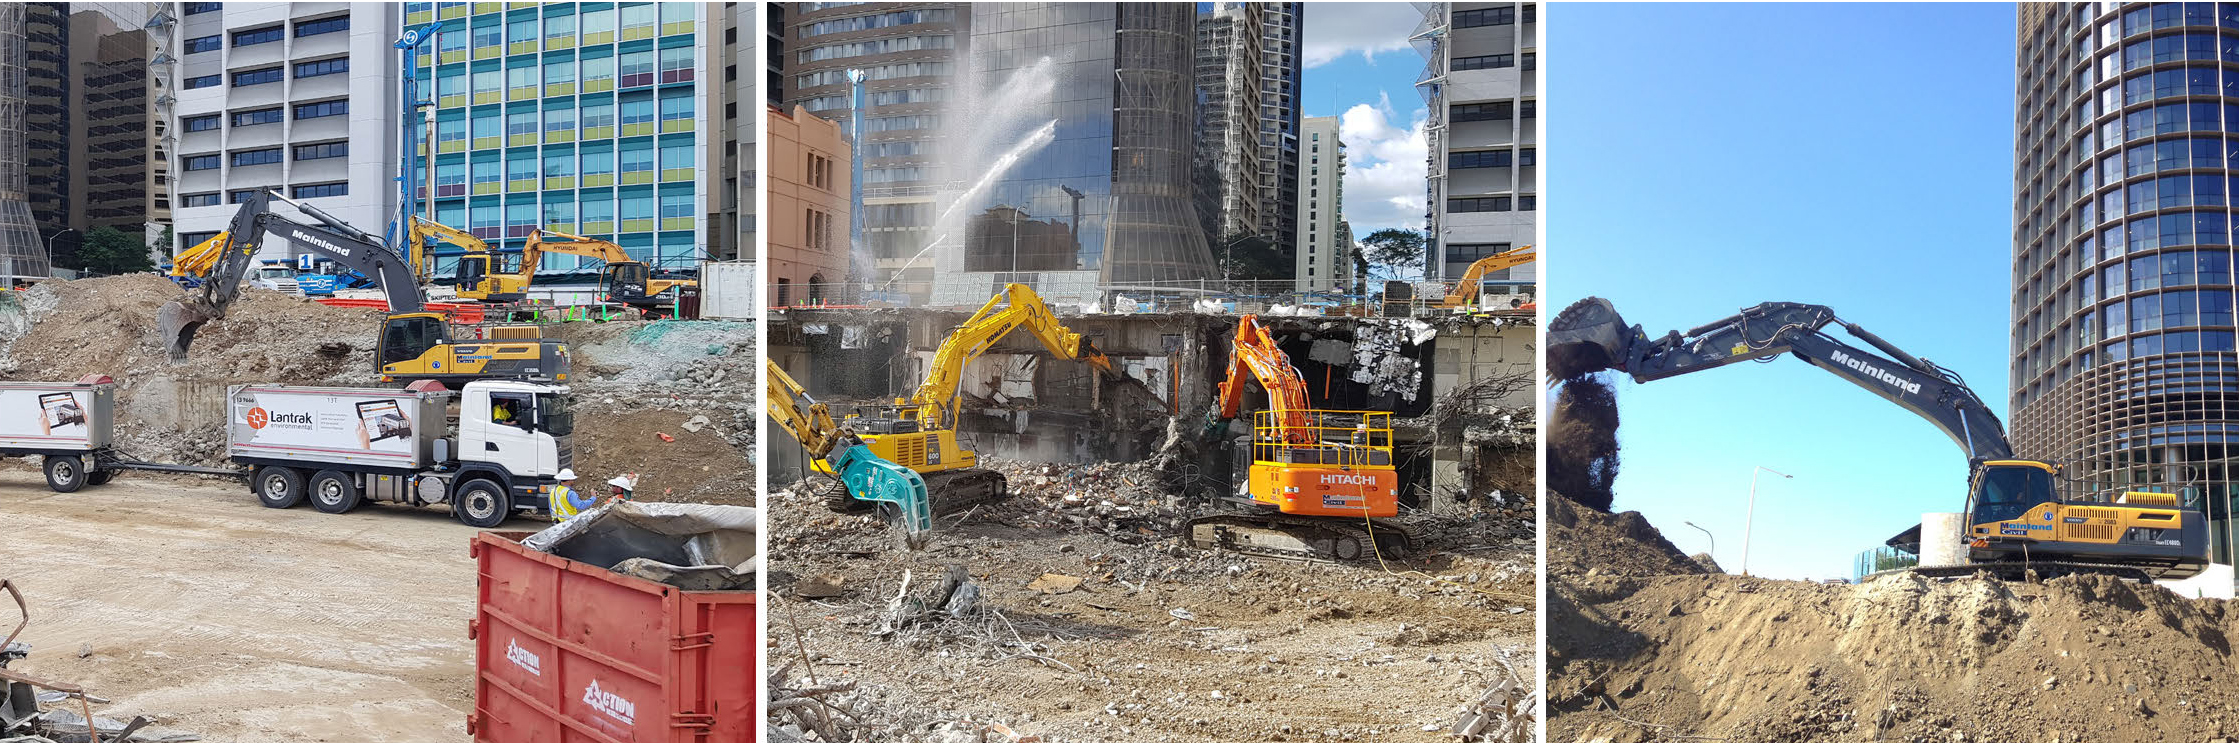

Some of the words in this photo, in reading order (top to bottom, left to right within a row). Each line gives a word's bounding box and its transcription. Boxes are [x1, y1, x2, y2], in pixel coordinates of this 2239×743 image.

[292, 229, 351, 257] Mainland
[301, 254, 311, 269] 1
[1508, 255, 1534, 264] HYUNDAI
[986, 321, 1012, 345] KOMATSU
[1830, 349, 1922, 395] Mainland
[270, 410, 313, 425] Lantrak
[270, 423, 313, 431] environmental
[927, 452, 939, 460] 600
[1320, 474, 1376, 486] HITACHI
[2000, 522, 2053, 531] Mainland
